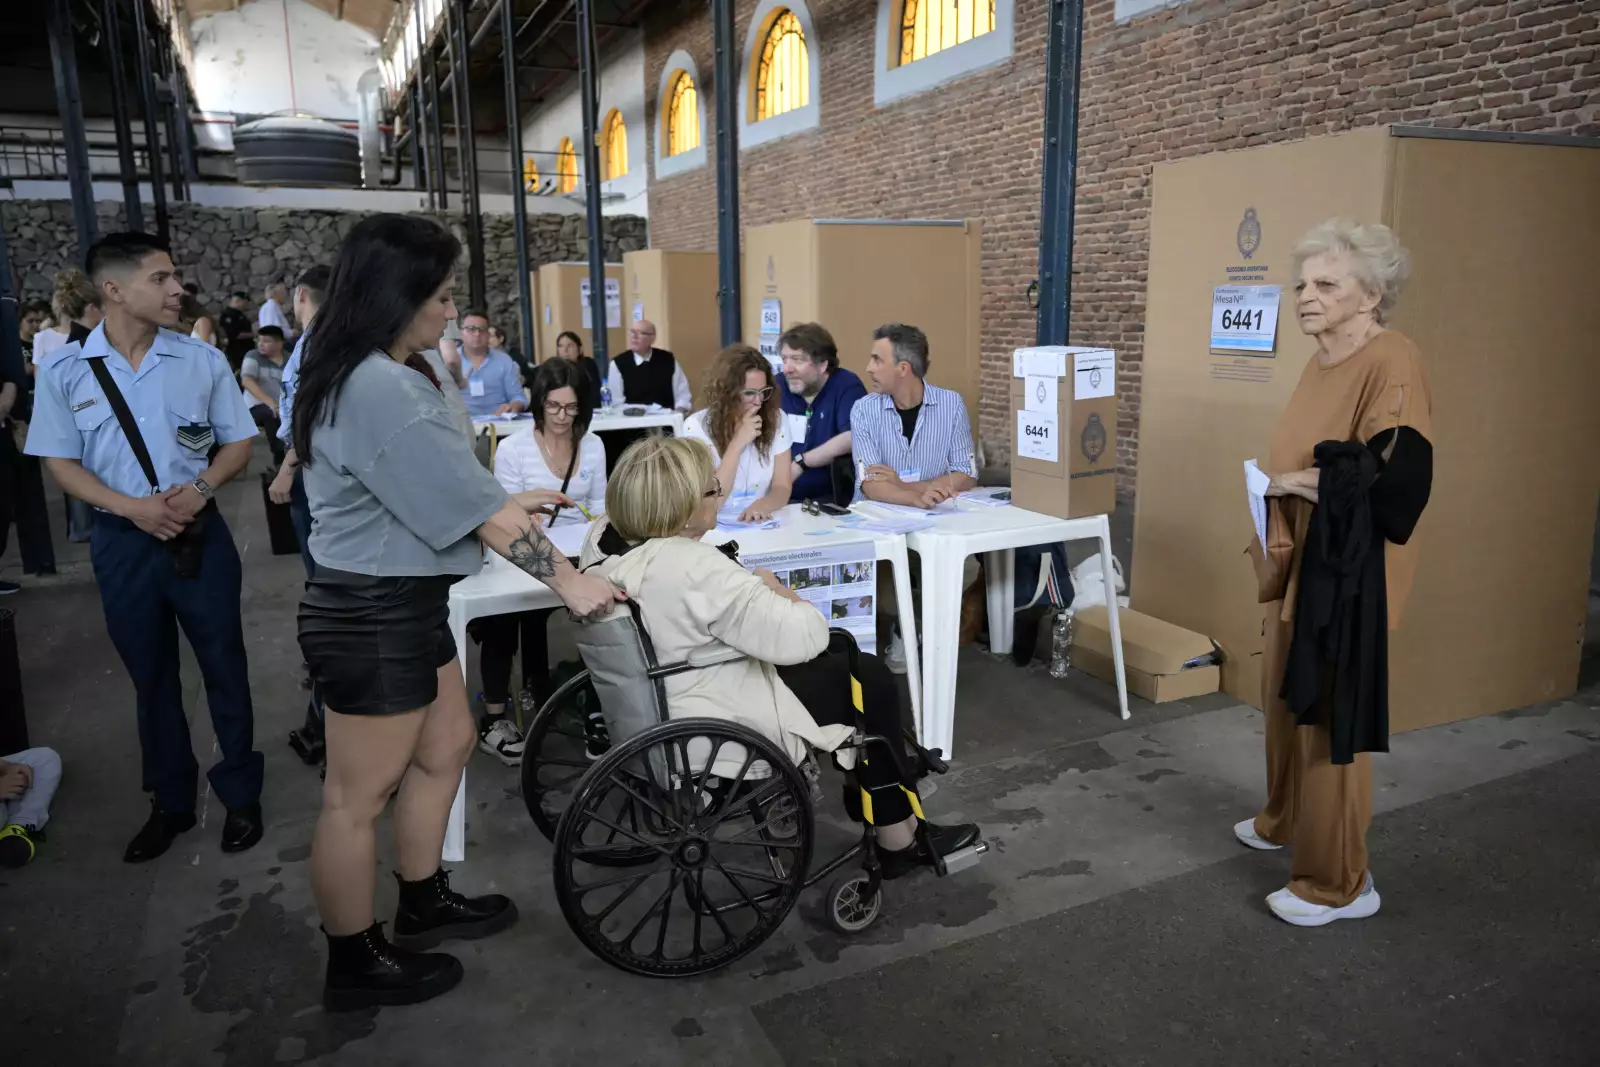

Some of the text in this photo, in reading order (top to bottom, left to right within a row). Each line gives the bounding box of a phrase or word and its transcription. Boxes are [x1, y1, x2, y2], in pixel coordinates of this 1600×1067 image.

[1215, 295, 1232, 303] Mesa
[1221, 309, 1263, 330] 6441
[1025, 425, 1049, 438] 6441
[743, 551, 822, 565] Disposiciones electorales
